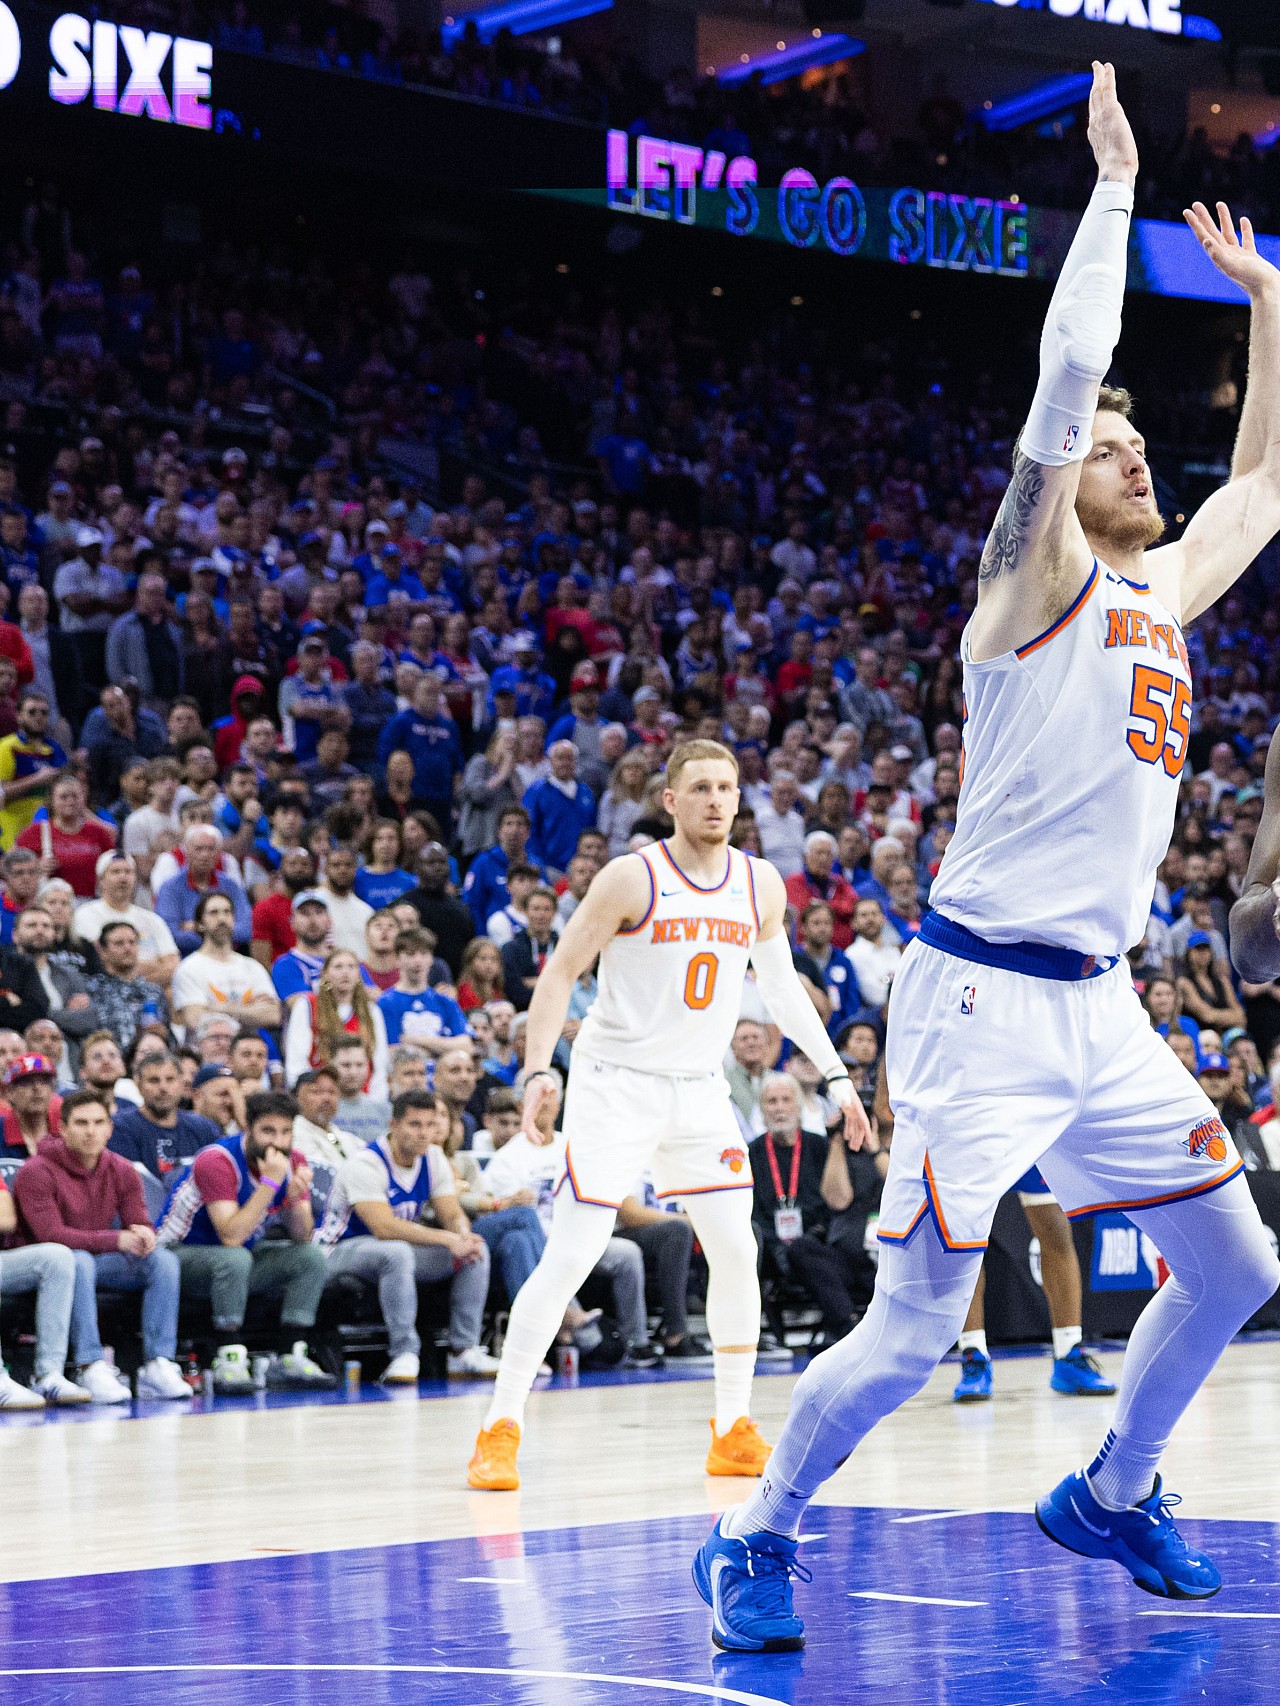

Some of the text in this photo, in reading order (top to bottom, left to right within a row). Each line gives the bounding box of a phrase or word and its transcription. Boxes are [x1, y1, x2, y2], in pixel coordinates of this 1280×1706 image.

[49, 13, 212, 130] SIXE
[607, 129, 1028, 276] LET'S GO SIXE
[1126, 663, 1193, 779] 55
[651, 917, 753, 948] NEW YORK
[684, 952, 719, 1010] 0
[1189, 1116, 1226, 1155] KNICKS
